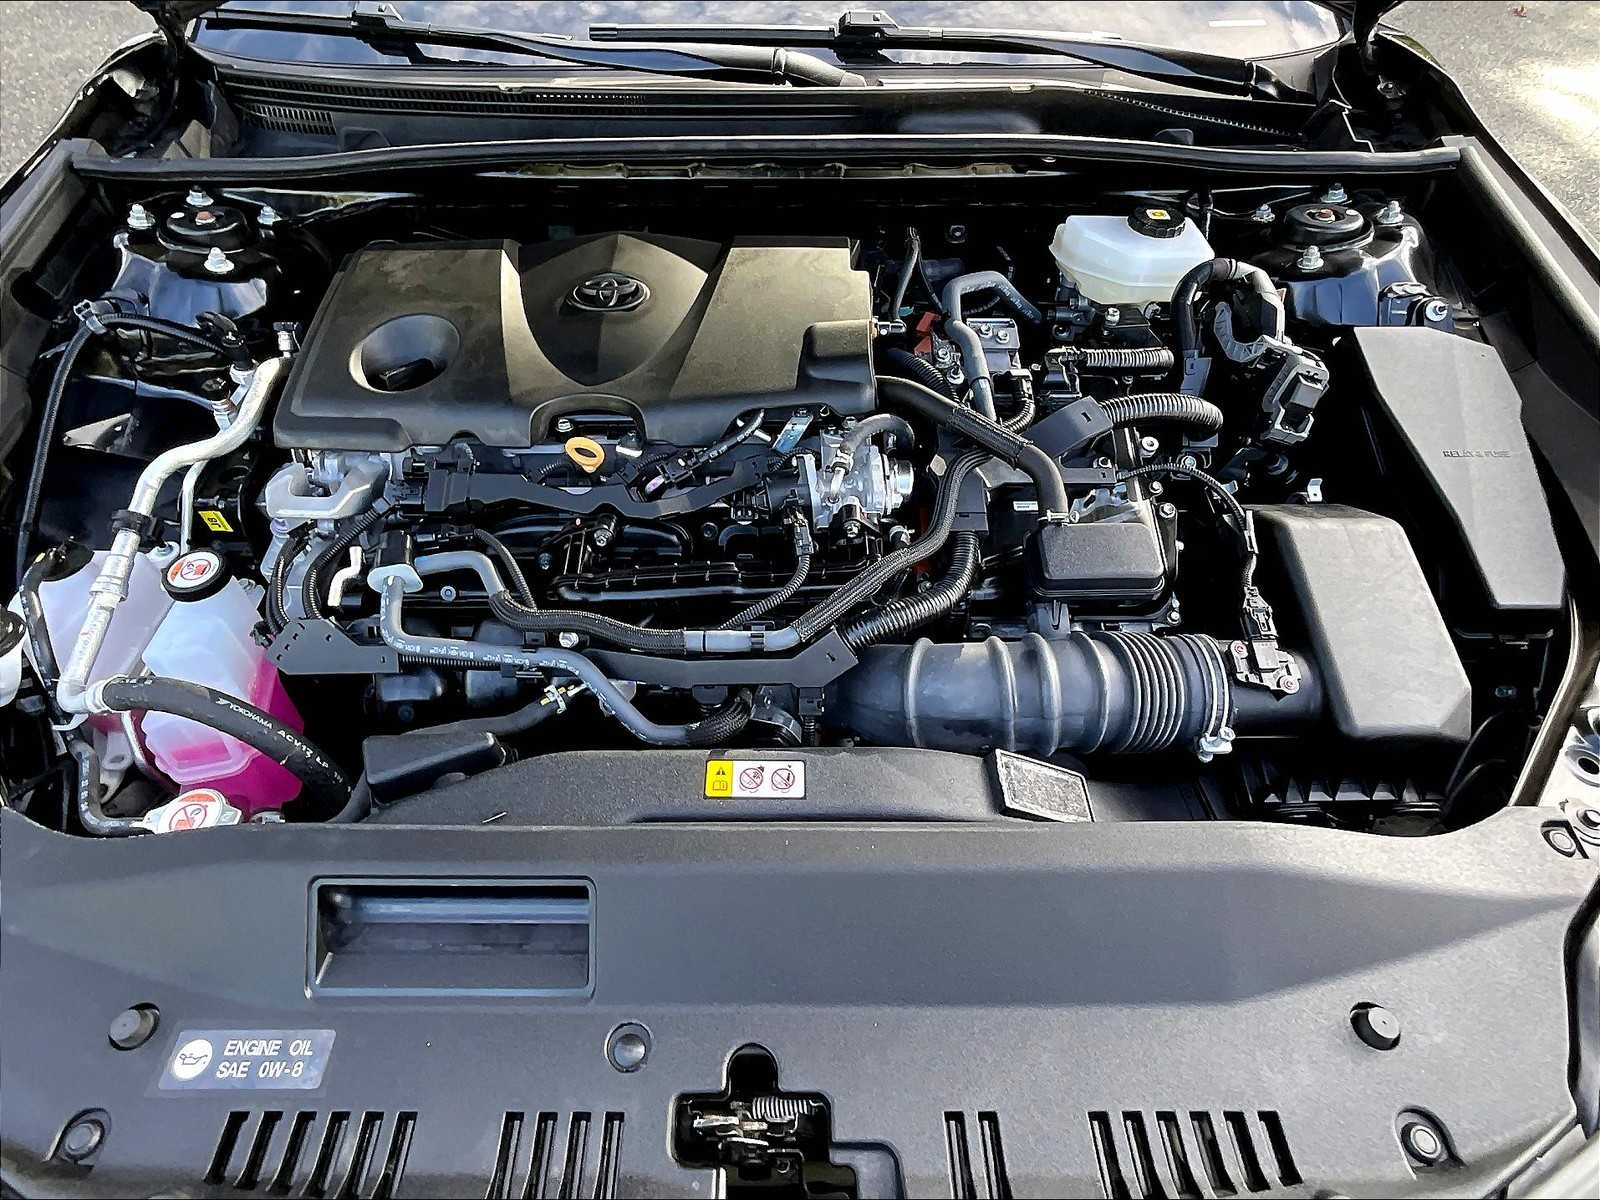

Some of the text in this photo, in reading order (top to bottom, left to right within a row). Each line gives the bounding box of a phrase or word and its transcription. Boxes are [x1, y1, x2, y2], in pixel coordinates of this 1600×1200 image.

[228, 702, 274, 730] YOKOHAMA
[223, 1039, 314, 1057] ENGINE OIL
[215, 1061, 251, 1080] SAE
